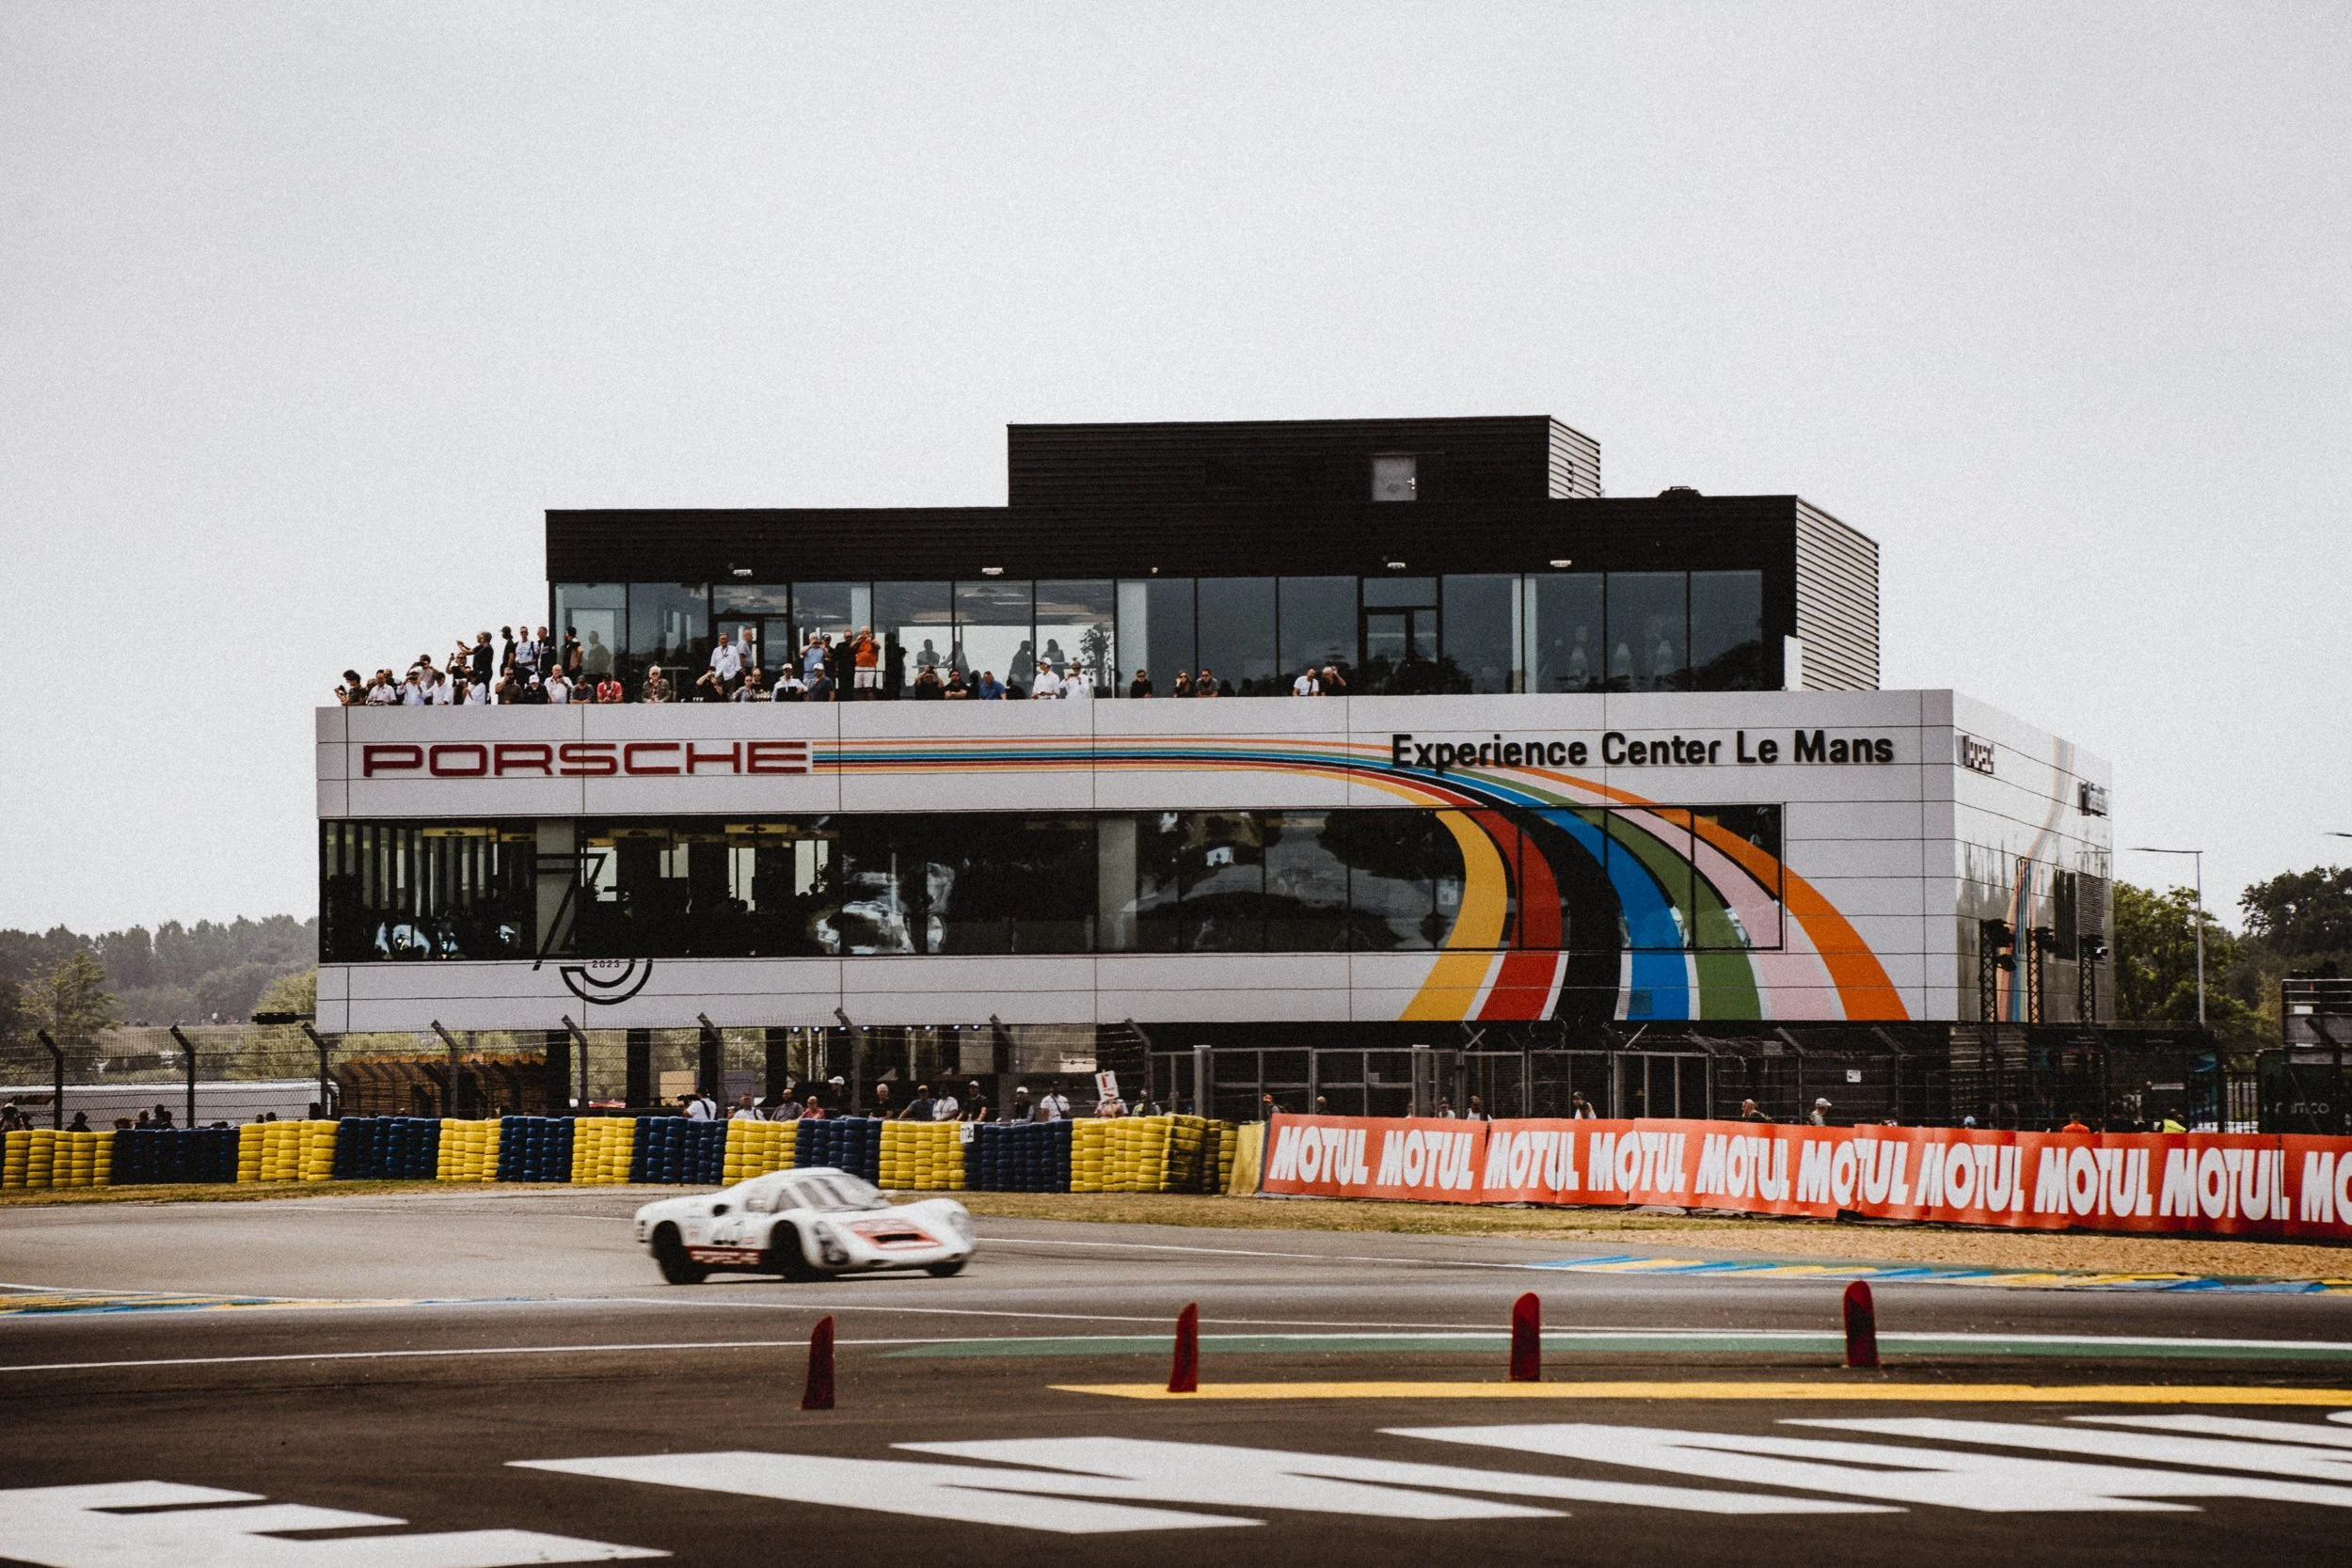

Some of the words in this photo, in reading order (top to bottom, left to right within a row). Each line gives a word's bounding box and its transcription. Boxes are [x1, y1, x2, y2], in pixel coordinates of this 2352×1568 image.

[362, 741, 807, 777] PORSCHE
[1391, 734, 1588, 776] Experience
[1601, 731, 1722, 766] Center
[1737, 730, 1778, 764] Le
[1794, 729, 1894, 764] Mans
[592, 959, 620, 969] 2023
[1268, 1126, 1369, 1185] MOTUL
[1376, 1130, 1474, 1190] MOTUL
[1483, 1131, 1580, 1192] MOTUL
[1588, 1132, 1686, 1193] MOTUL
[1694, 1134, 1790, 1201] MOTUL
[1797, 1138, 1909, 1206] MOTUL
[1914, 1142, 2025, 1212] MOTUL
[2034, 1146, 2153, 1216] MOTUL
[2160, 1148, 2290, 1221] MOTUL
